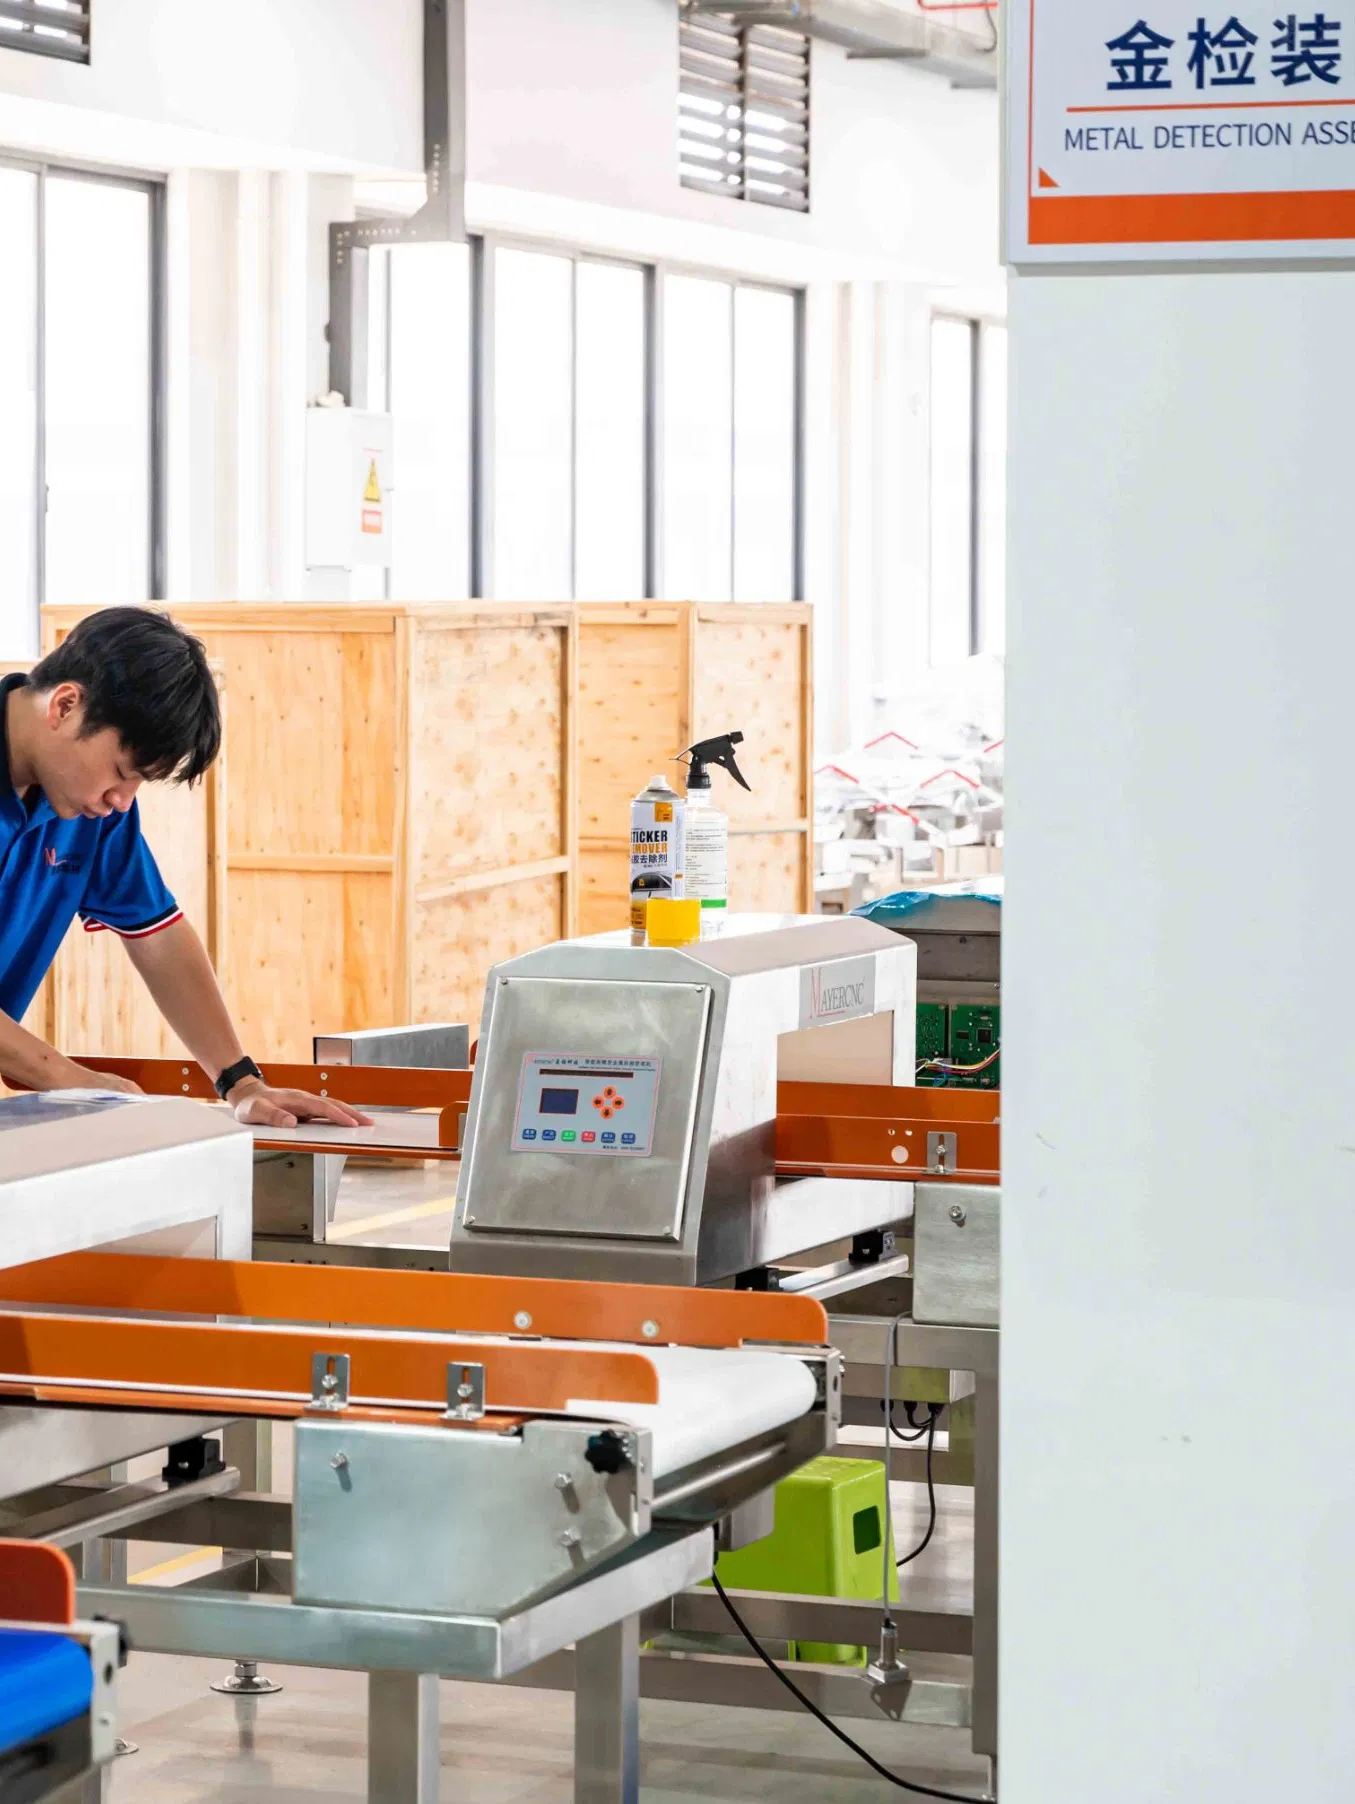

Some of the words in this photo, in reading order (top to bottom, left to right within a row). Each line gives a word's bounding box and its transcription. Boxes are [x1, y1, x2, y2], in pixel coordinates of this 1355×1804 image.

[1105, 13, 1341, 90] 金检装
[1065, 126, 1144, 151] METAL
[1154, 123, 1292, 149] DETECTION
[631, 830, 668, 843] TICKER
[809, 968, 865, 1019] MAYERCNC
